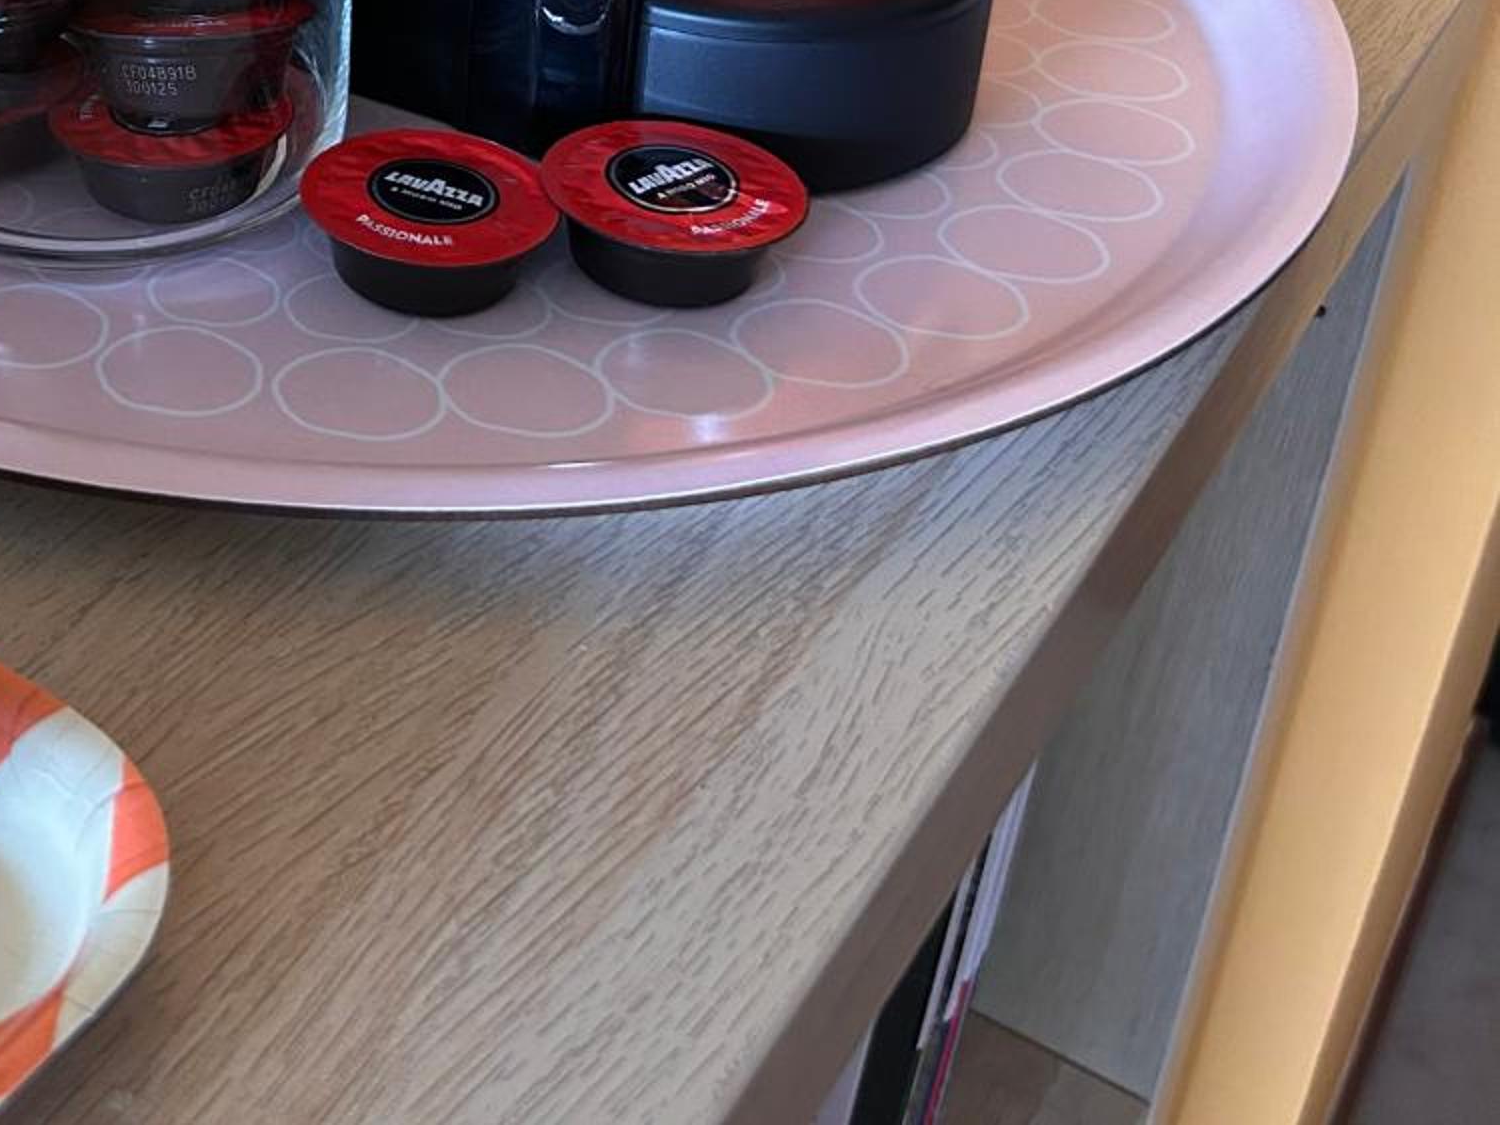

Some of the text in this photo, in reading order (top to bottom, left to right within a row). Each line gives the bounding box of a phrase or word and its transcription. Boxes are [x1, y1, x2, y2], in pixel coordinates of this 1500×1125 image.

[384, 171, 484, 207] LAVAZZA
[628, 159, 714, 194] LAVAZZA
[355, 214, 453, 246] PASSIONALE
